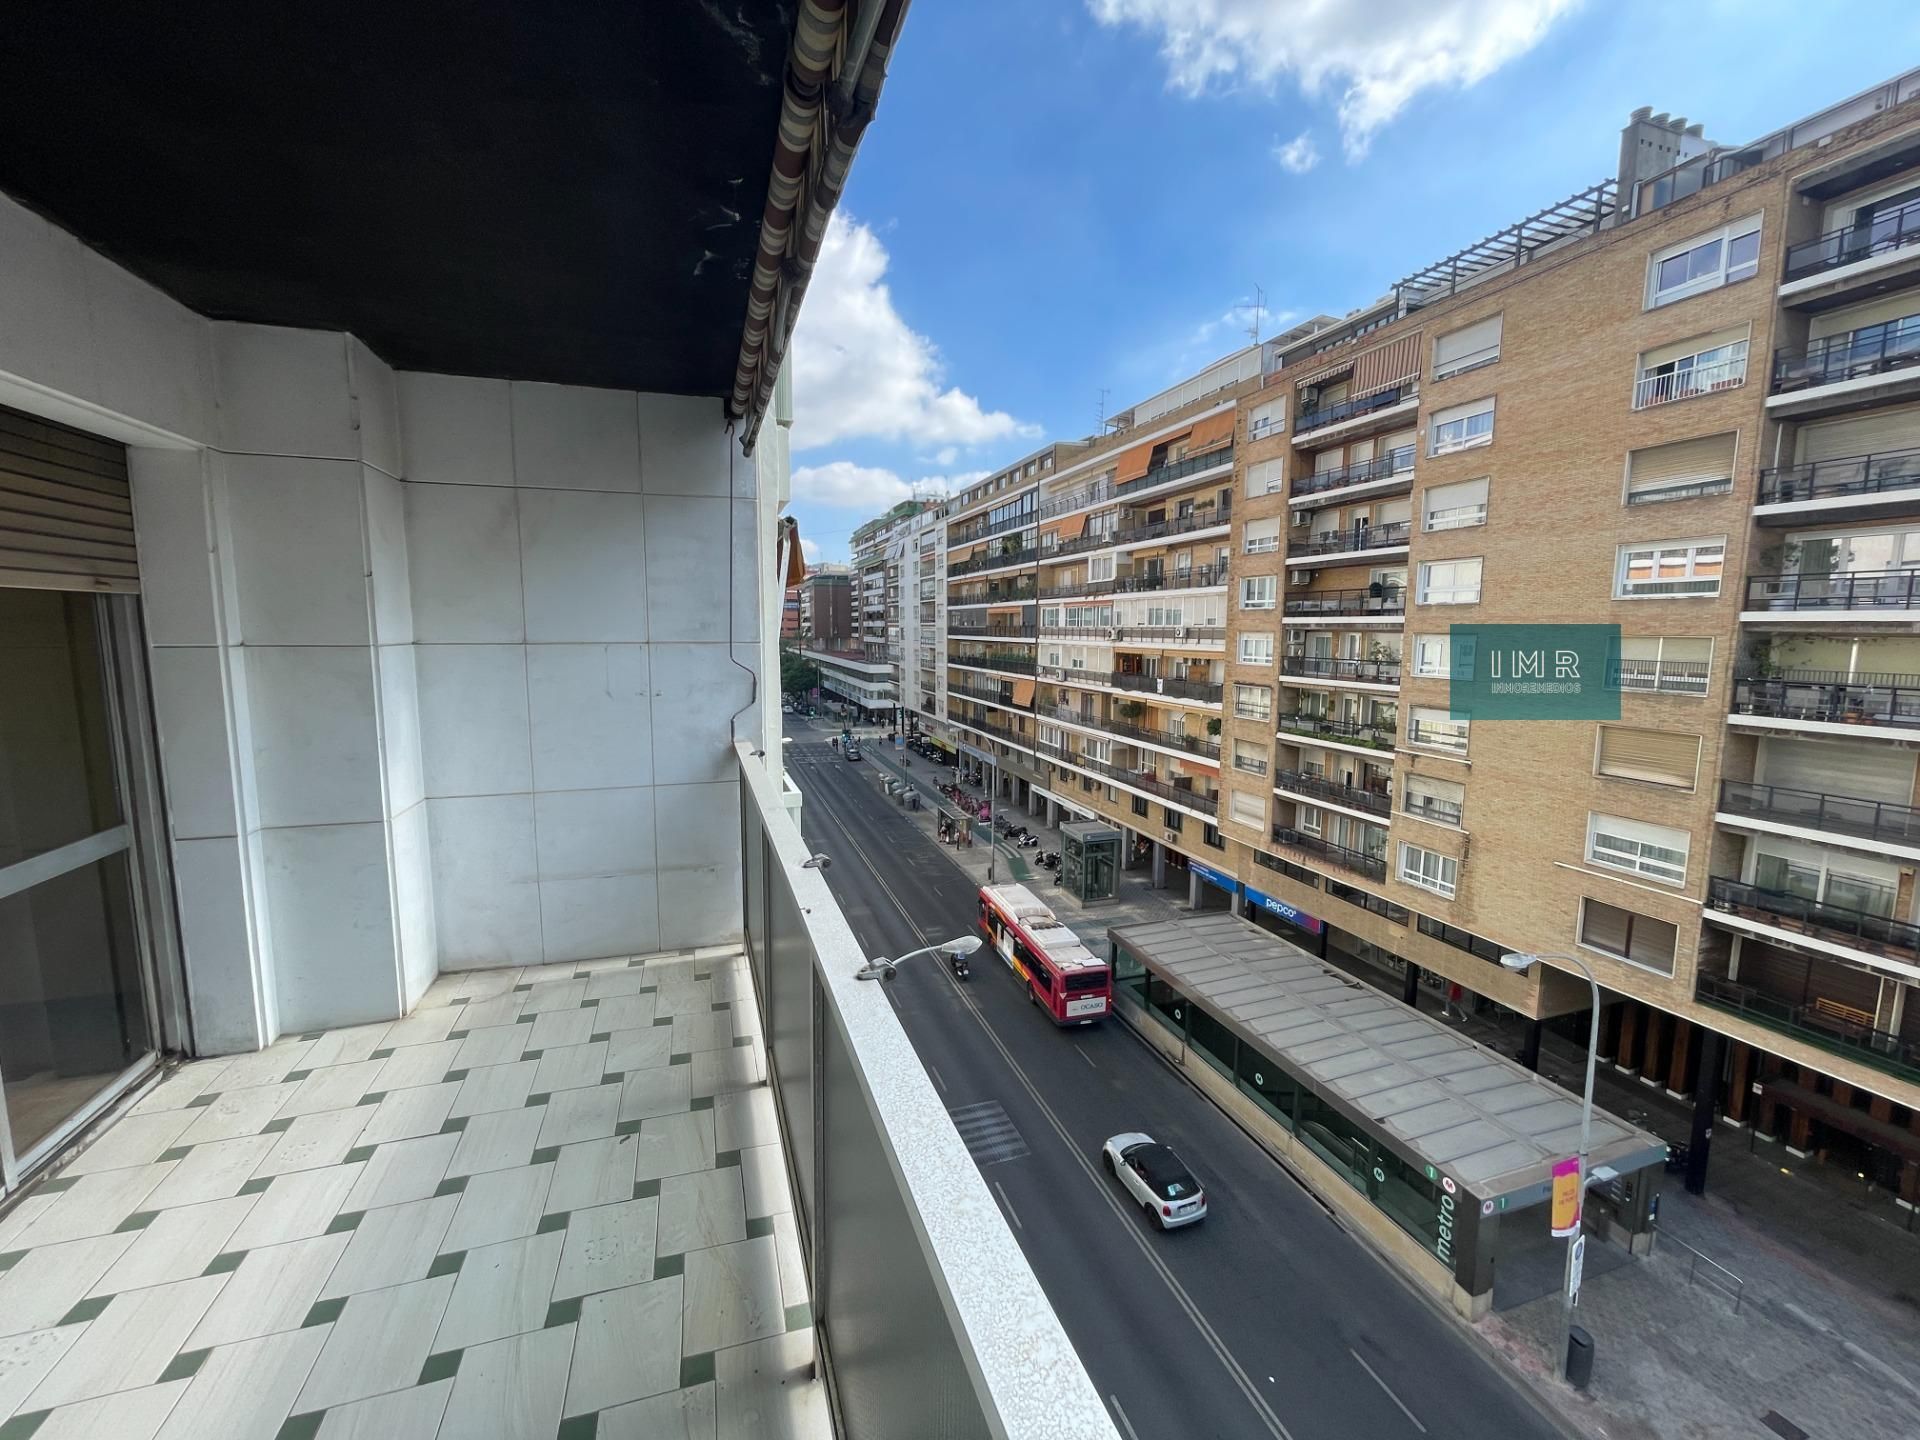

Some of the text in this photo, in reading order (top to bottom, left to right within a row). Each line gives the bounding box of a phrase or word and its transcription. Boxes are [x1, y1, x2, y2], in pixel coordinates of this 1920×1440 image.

[1266, 898, 1294, 918] pepco
[1080, 1001, 1104, 1011] OCASO
[1436, 1194, 1455, 1263] metro
